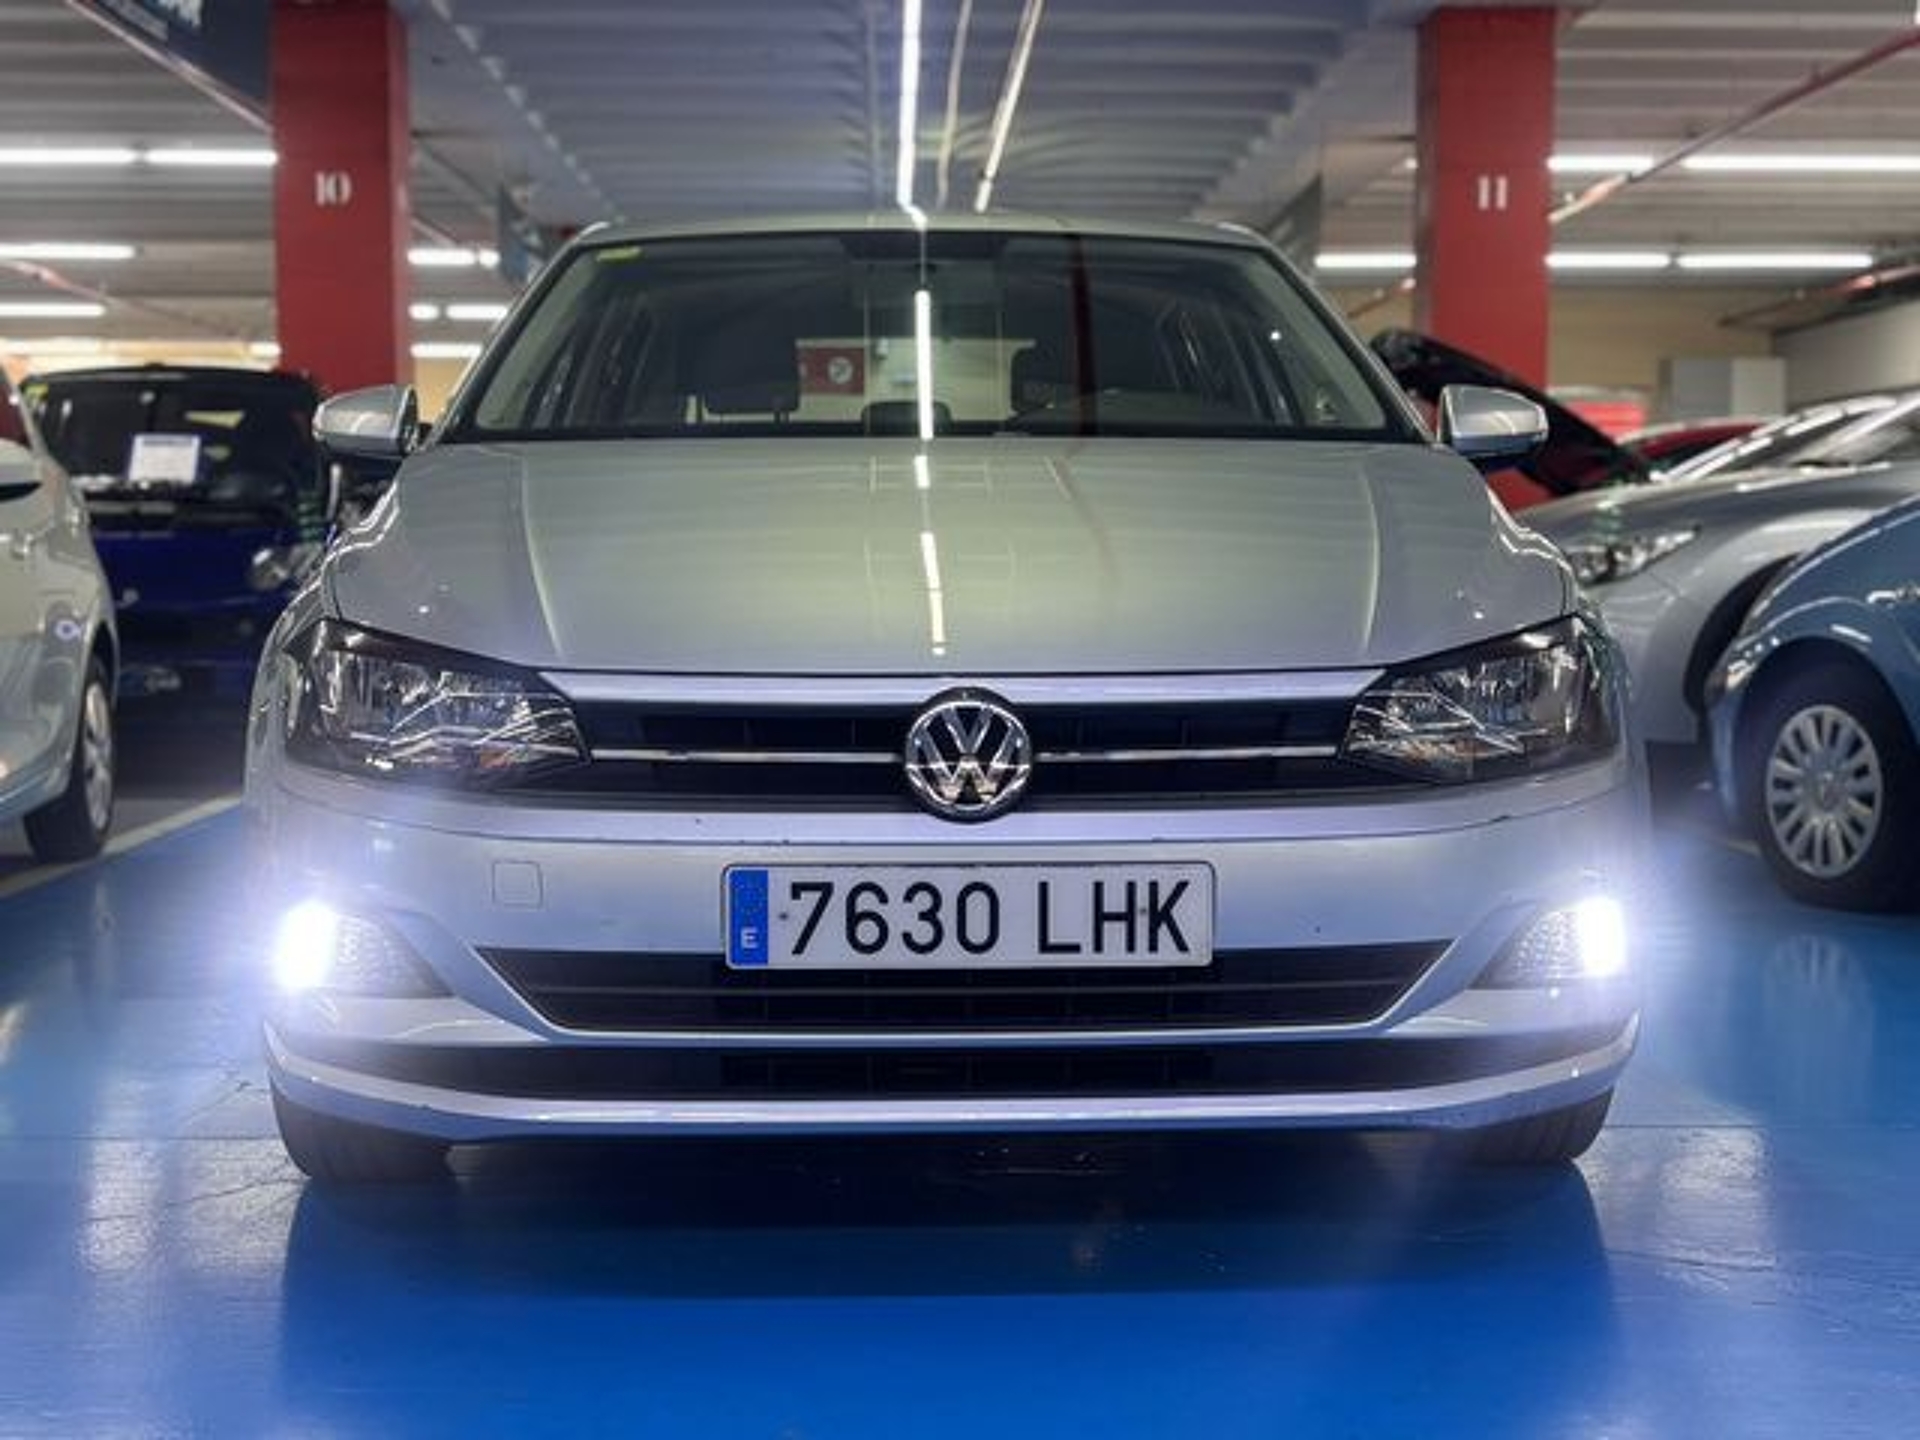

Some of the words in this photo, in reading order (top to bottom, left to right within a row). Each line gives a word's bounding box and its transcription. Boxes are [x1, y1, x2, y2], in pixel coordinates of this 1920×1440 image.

[315, 170, 352, 206] 10
[1478, 175, 1507, 210] 11
[790, 881, 1000, 955] 7630
[1037, 880, 1190, 954] LHK
[741, 927, 759, 949] E
